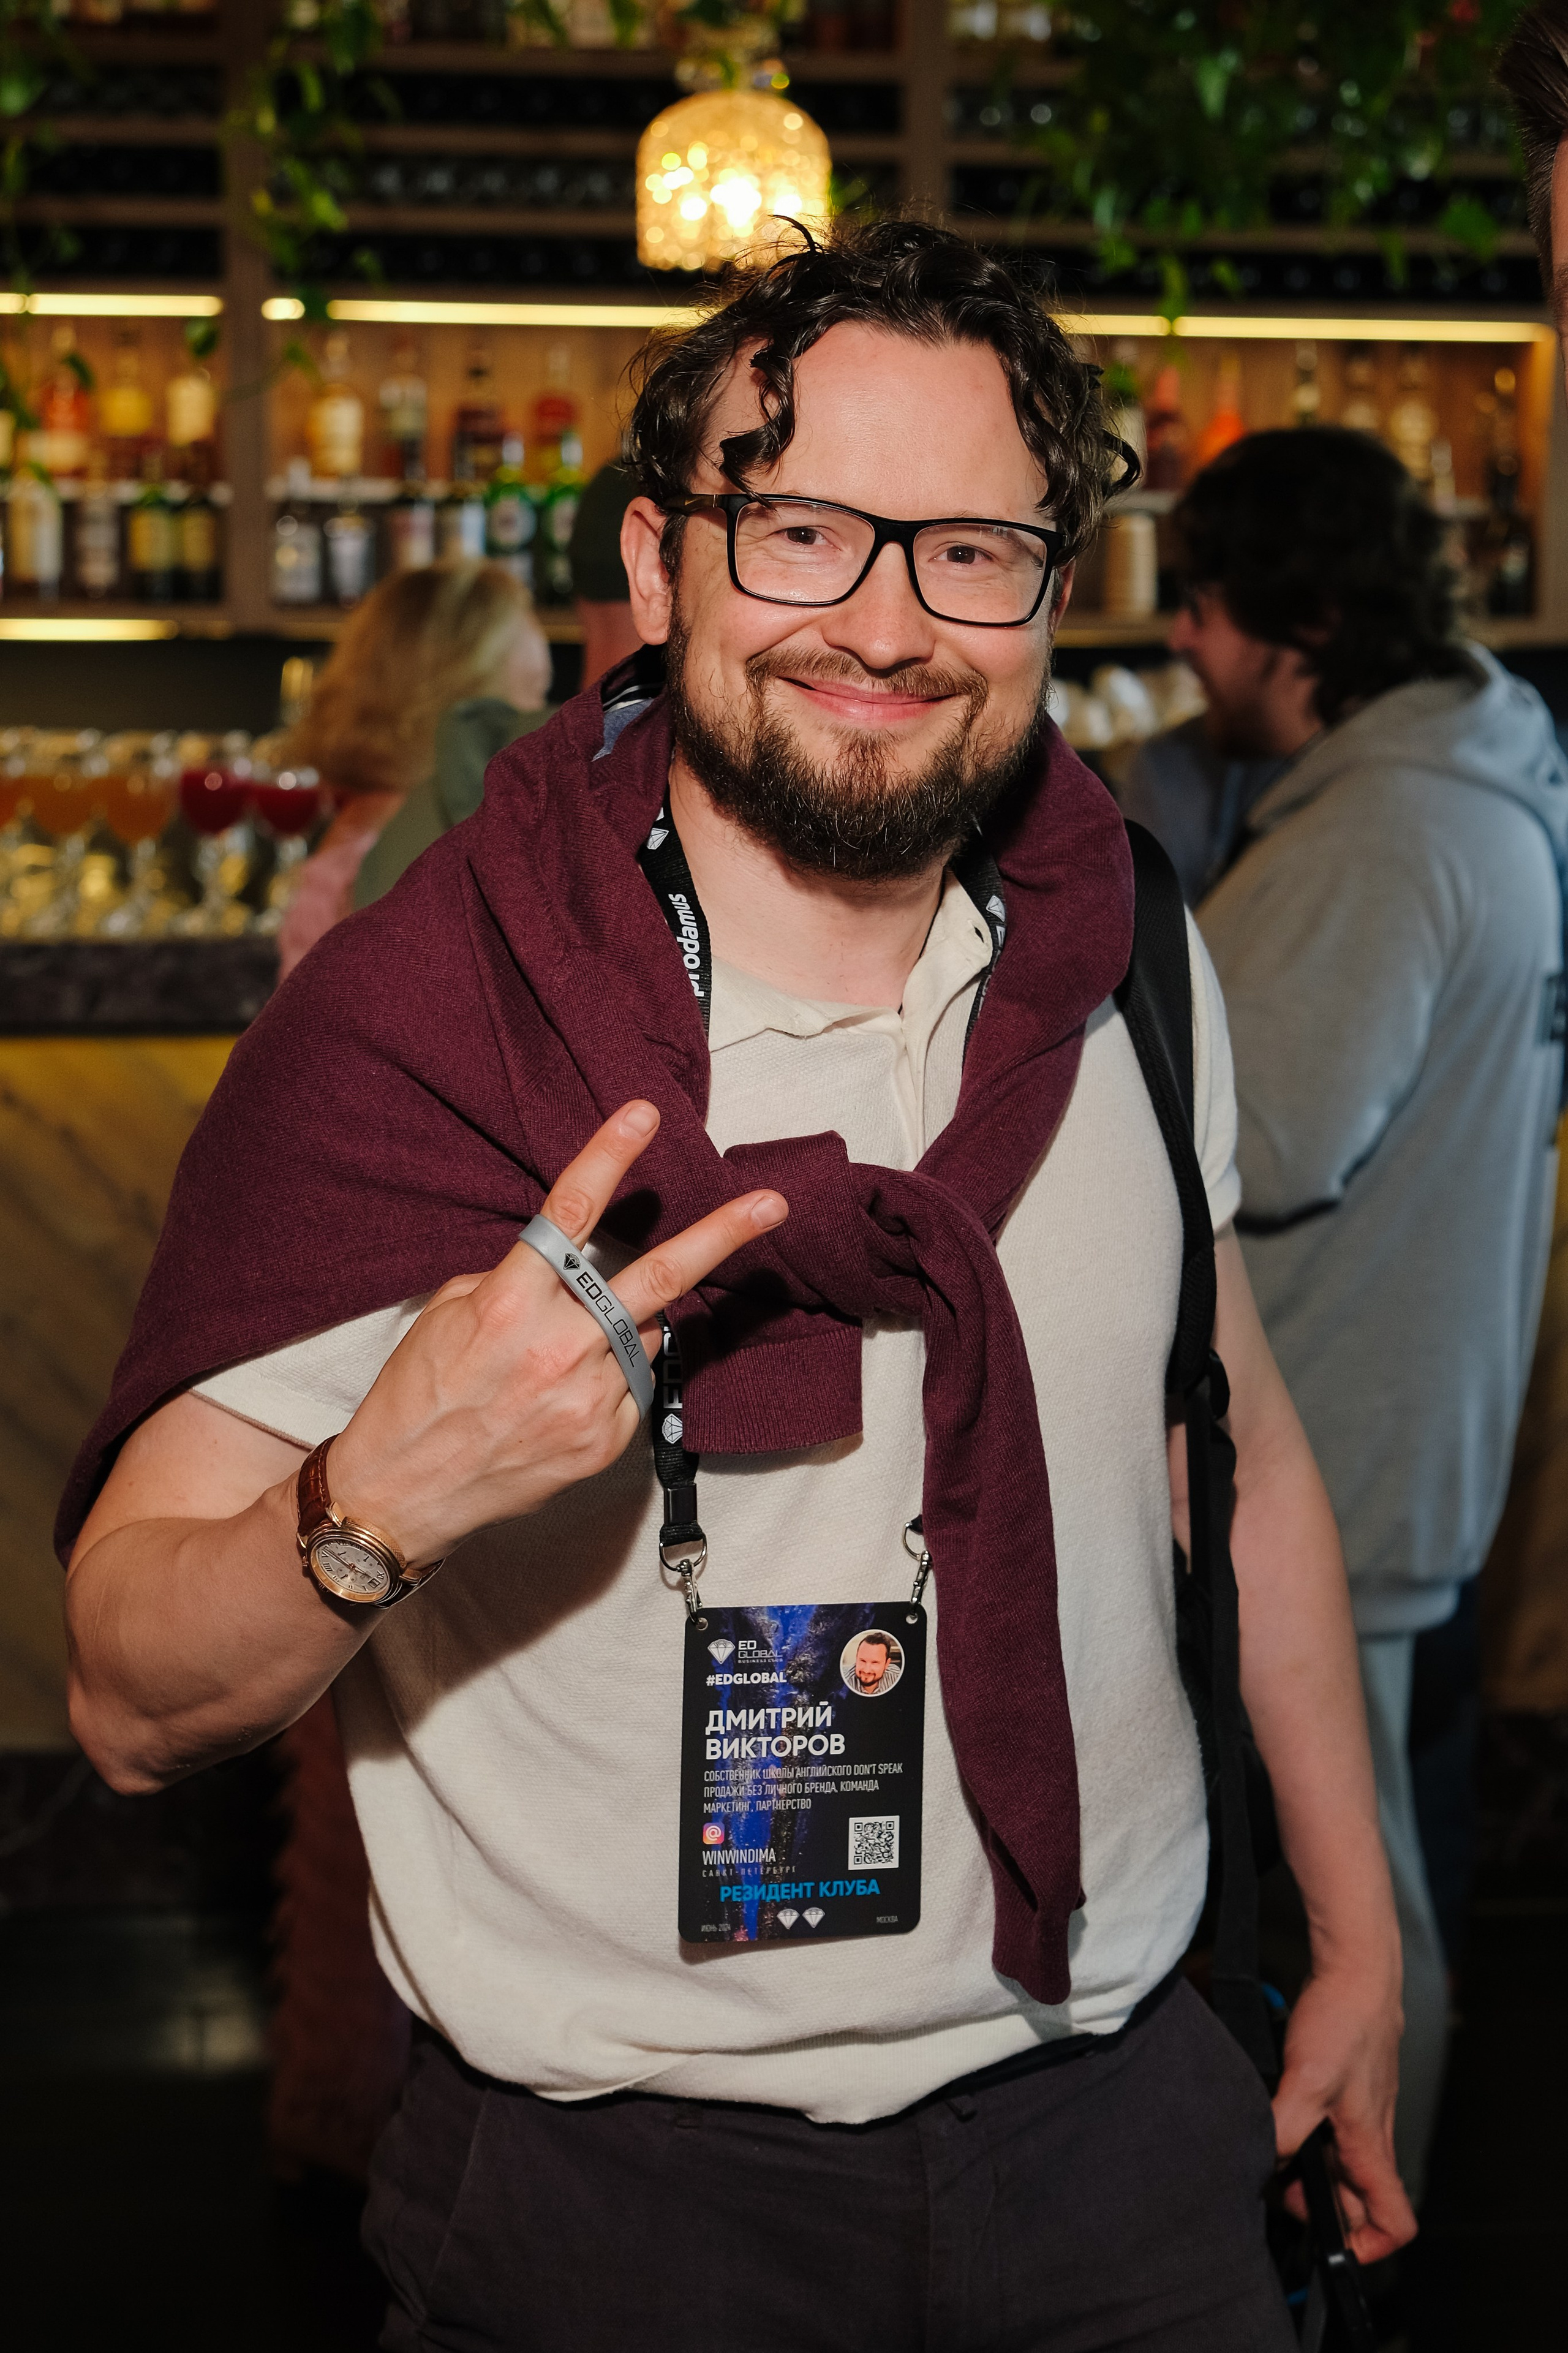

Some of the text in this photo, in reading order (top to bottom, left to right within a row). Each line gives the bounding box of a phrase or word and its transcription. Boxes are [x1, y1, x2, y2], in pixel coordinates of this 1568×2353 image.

[576, 1271, 640, 1368] EDGLOBAL
[738, 1640, 757, 1650] ED
[737, 1650, 783, 1659] GLOBAL
[706, 1672, 788, 1686] #EDGLOBAL
[705, 1701, 832, 1735] ДМИТРИЙ
[706, 1734, 845, 1760] ВИКТОРОВ
[704, 1769, 761, 1782] СОБСТВЕННИК
[796, 1764, 852, 1778] АНГЛИЙСКОГО
[878, 1762, 903, 1775] SPEAK
[704, 1786, 745, 1798] ПРОДАЖИ
[747, 1785, 763, 1796] БЕЗ
[764, 1783, 803, 1796] ЛИЧНОГО
[840, 1780, 880, 1792] КОМАНДА
[756, 1798, 812, 1811] ПАРТНЕРСТВО
[702, 1848, 777, 1865] WINWINDIMA
[720, 1878, 881, 1902] РЕЗИДЕНТ КЛУБА
